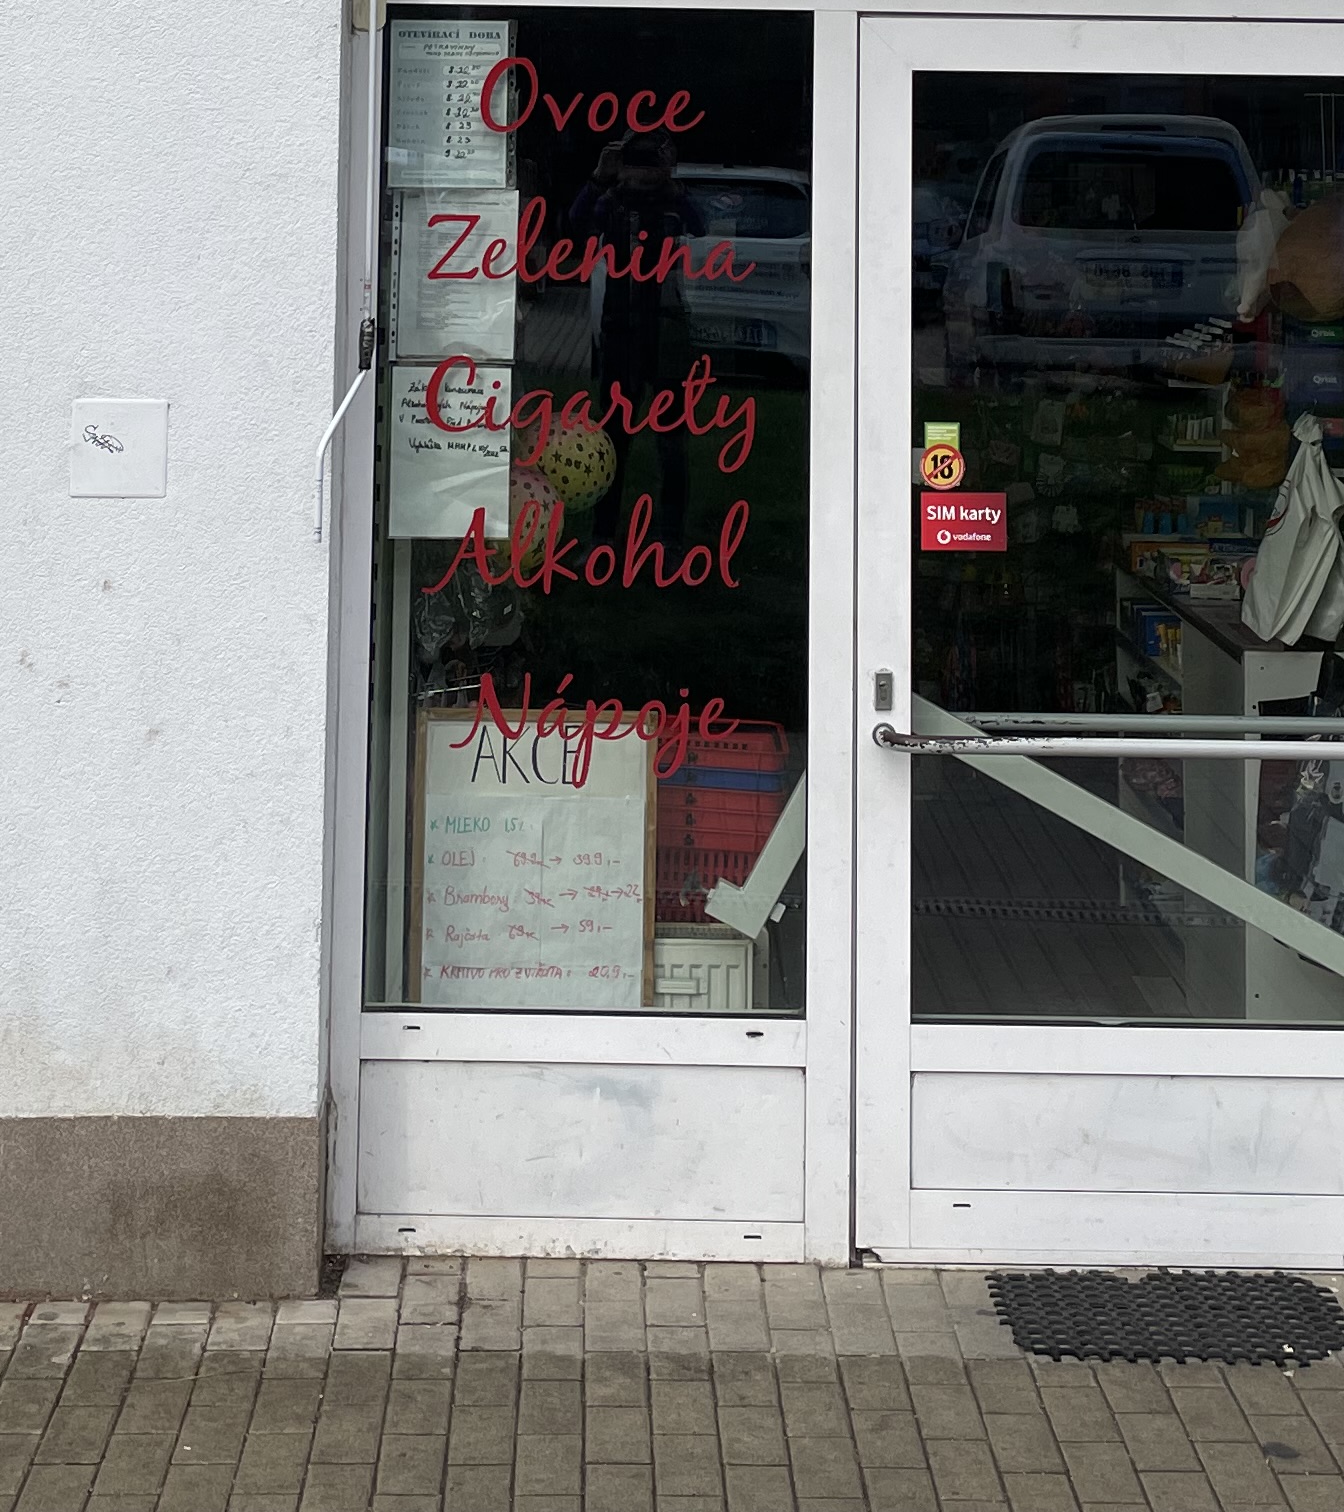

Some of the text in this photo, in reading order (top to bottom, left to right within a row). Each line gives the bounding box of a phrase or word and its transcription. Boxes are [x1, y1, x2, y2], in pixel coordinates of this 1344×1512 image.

[480, 56, 707, 133] Ovoce
[427, 196, 756, 283] Zelenina
[425, 355, 756, 474] Cigarety
[931, 454, 954, 479] 18
[421, 493, 750, 595] Alkohol
[926, 505, 1001, 524] SIM karty
[952, 532, 992, 541] vodafone
[449, 672, 740, 788] Nápoje
[470, 724, 582, 785] AKCE
[445, 816, 491, 834] MLEKO
